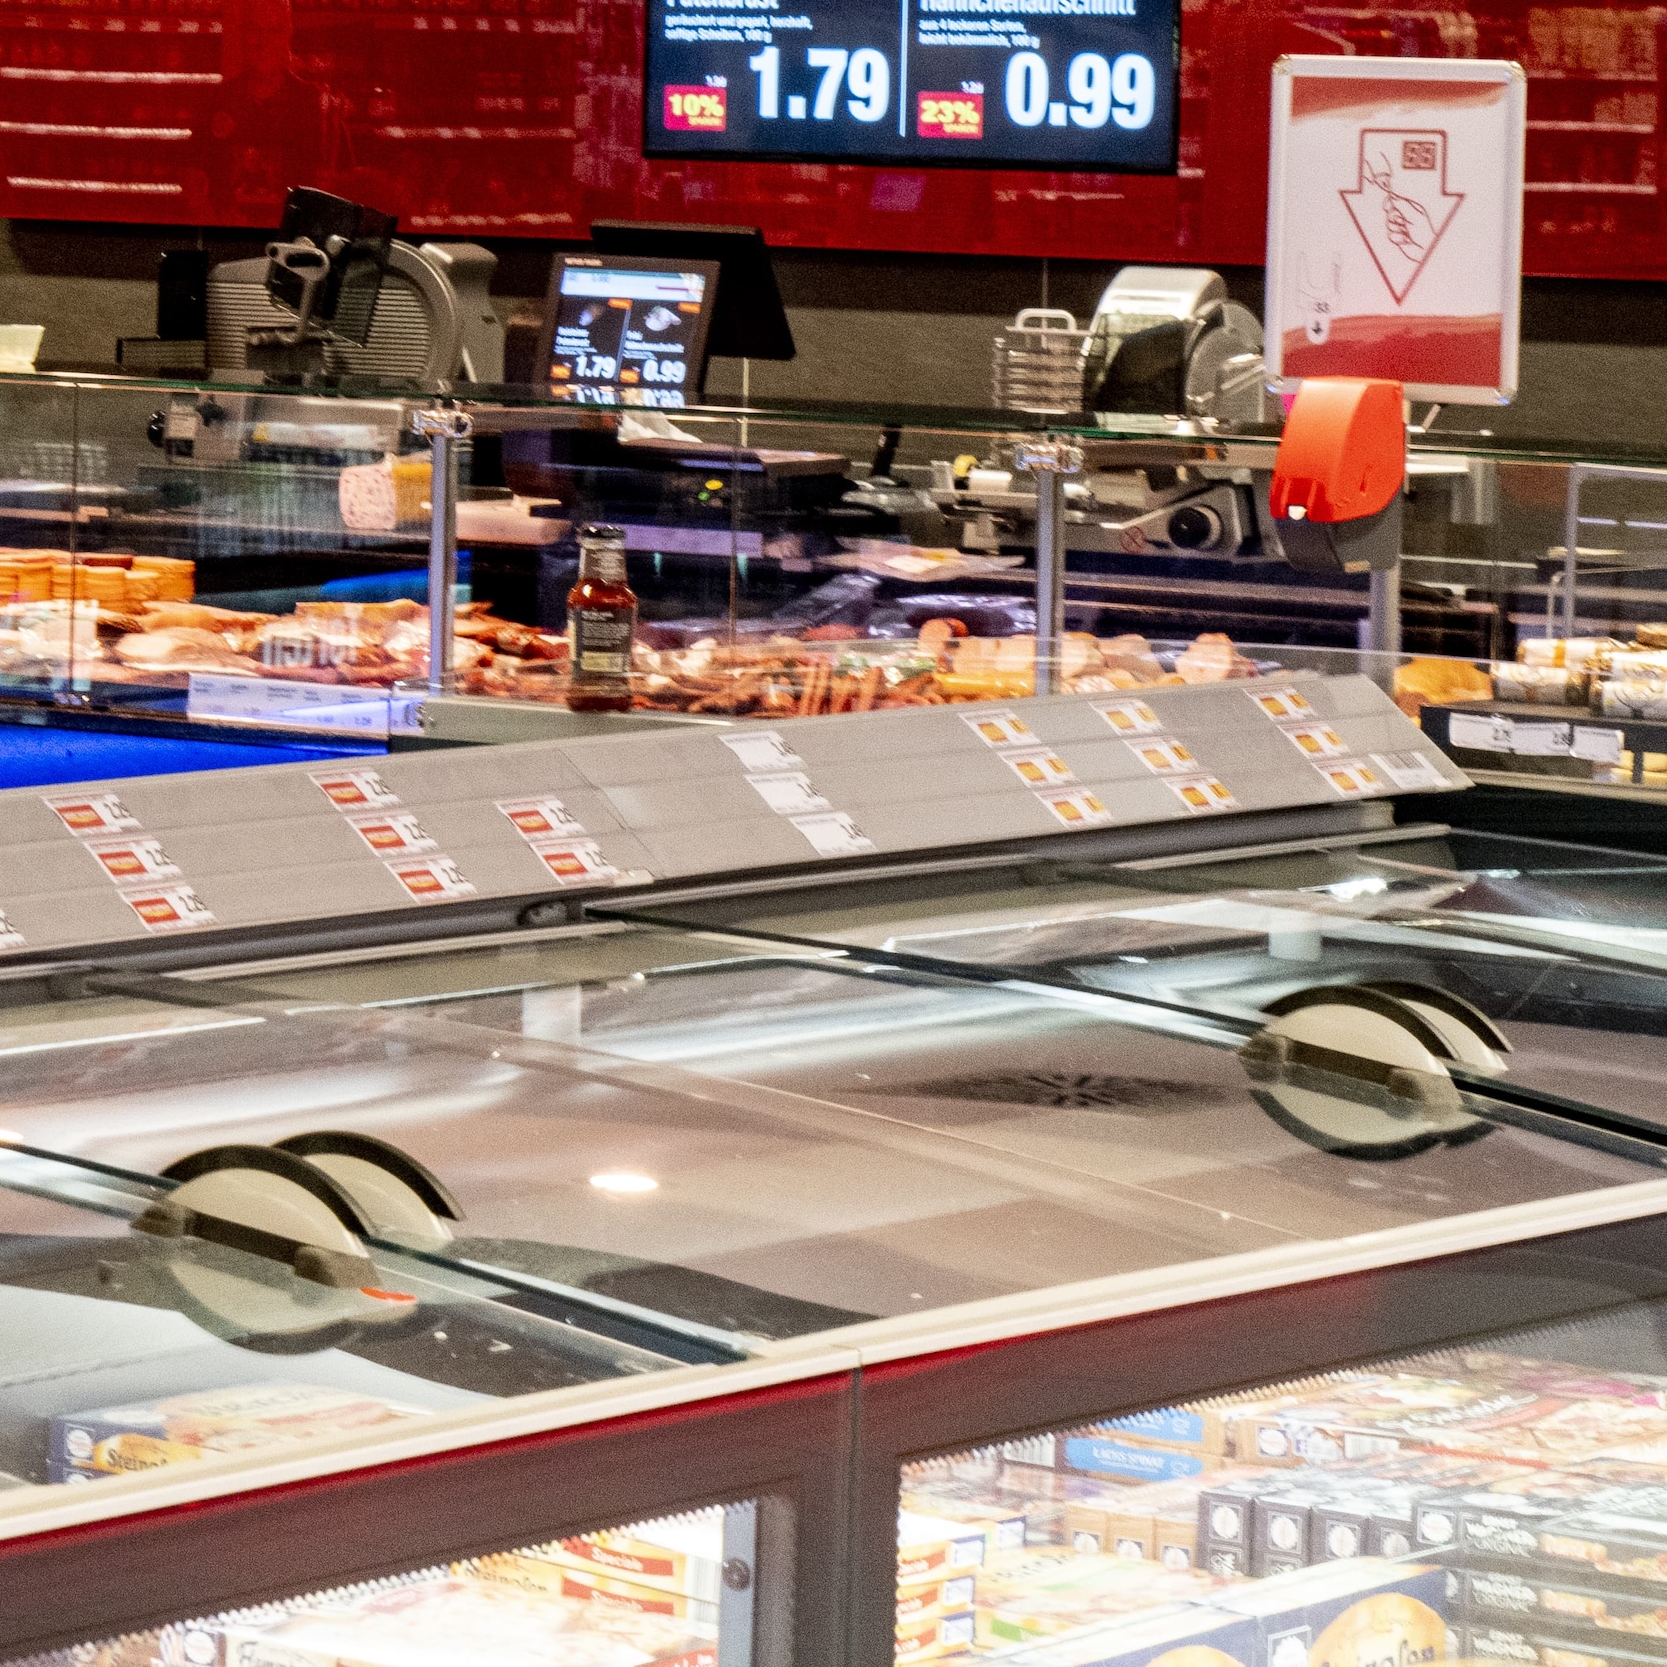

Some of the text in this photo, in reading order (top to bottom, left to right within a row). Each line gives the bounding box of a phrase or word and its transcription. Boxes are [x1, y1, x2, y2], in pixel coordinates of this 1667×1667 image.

[919, 19, 938, 31] aus
[749, 44, 890, 123] 1.79
[1004, 51, 1155, 130] 0.99
[668, 92, 724, 116] 10%
[920, 101, 980, 125] 23%
[575, 355, 617, 379] 1.79
[643, 359, 687, 384] 0.99
[103, 801, 135, 820] 2.29
[590, 1546, 644, 1573] Speciale
